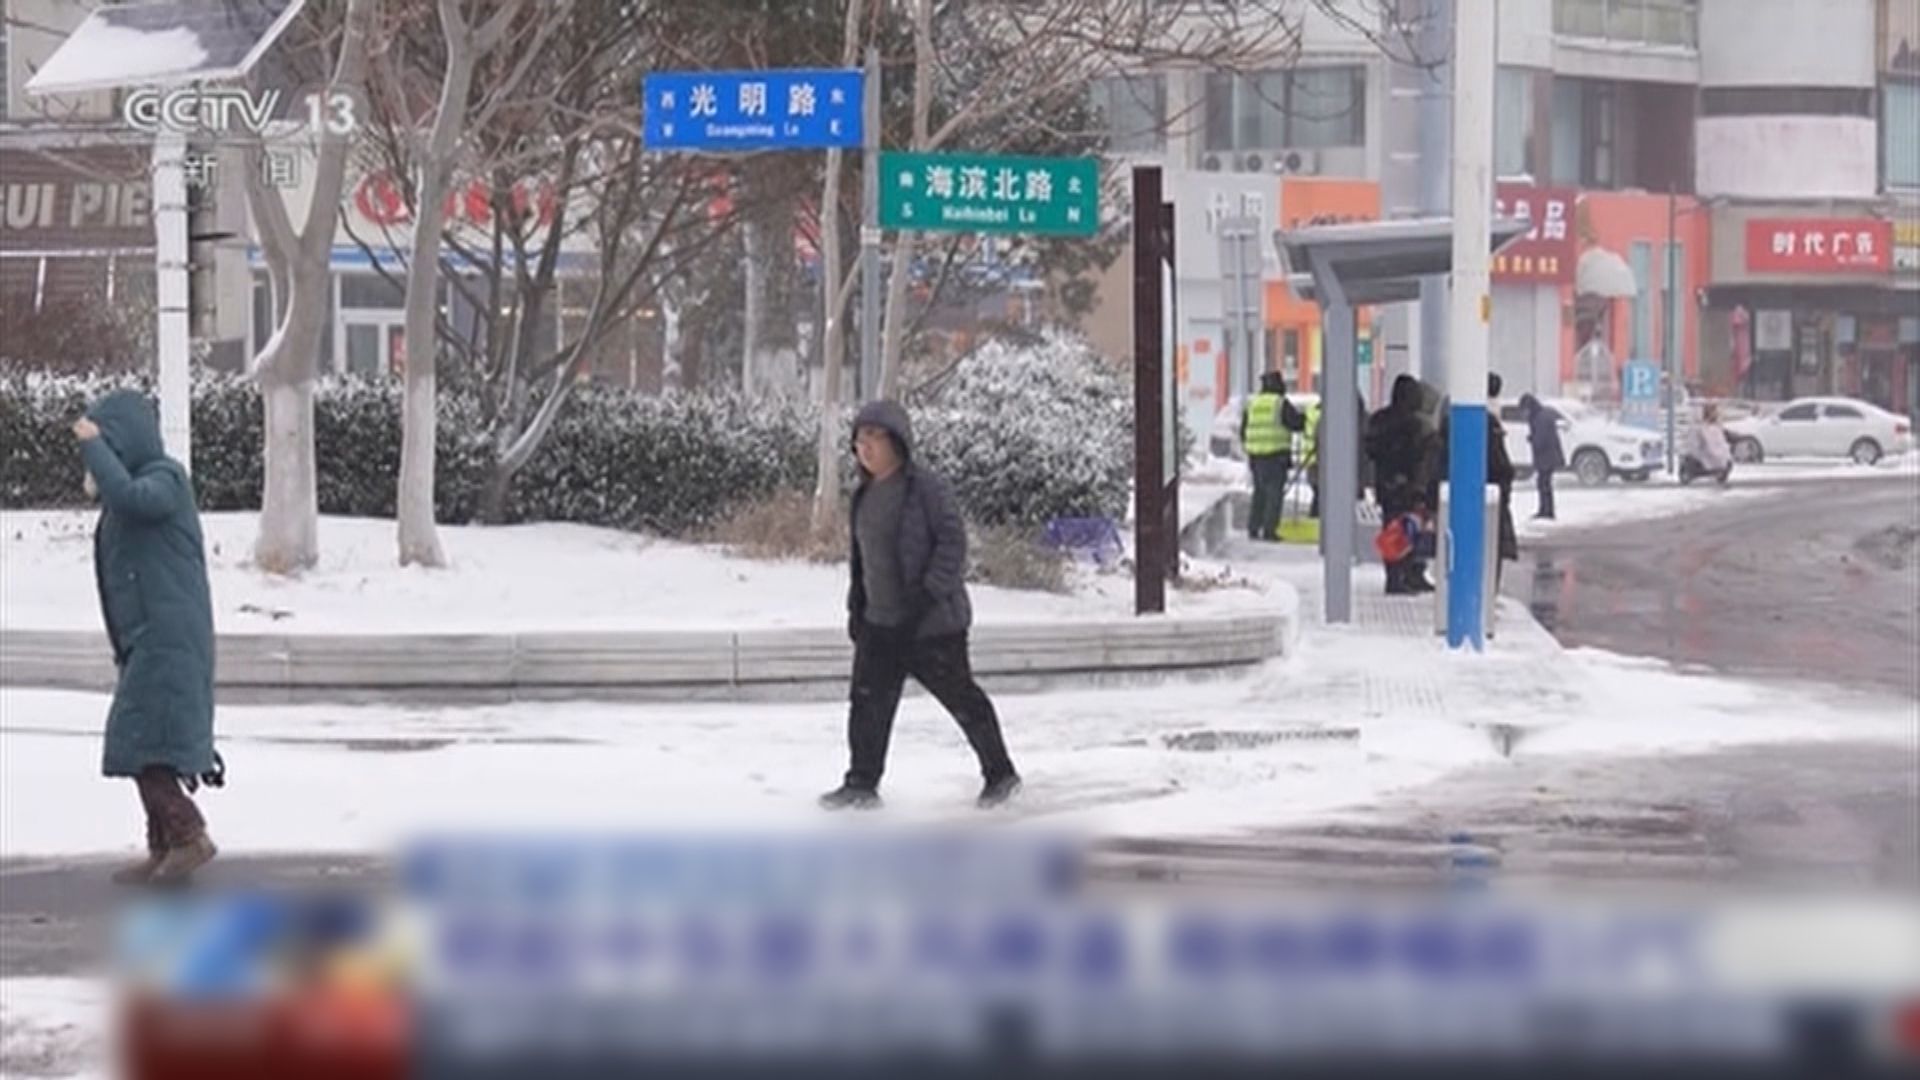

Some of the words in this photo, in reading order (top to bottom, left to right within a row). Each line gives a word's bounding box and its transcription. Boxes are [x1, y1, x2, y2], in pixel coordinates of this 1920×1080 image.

[689, 82, 816, 117] 光明路
[925, 166, 1052, 202] 海滨北路
[0, 182, 56, 229] UI
[901, 202, 913, 218] S
[1773, 231, 1873, 256] 时代广告
